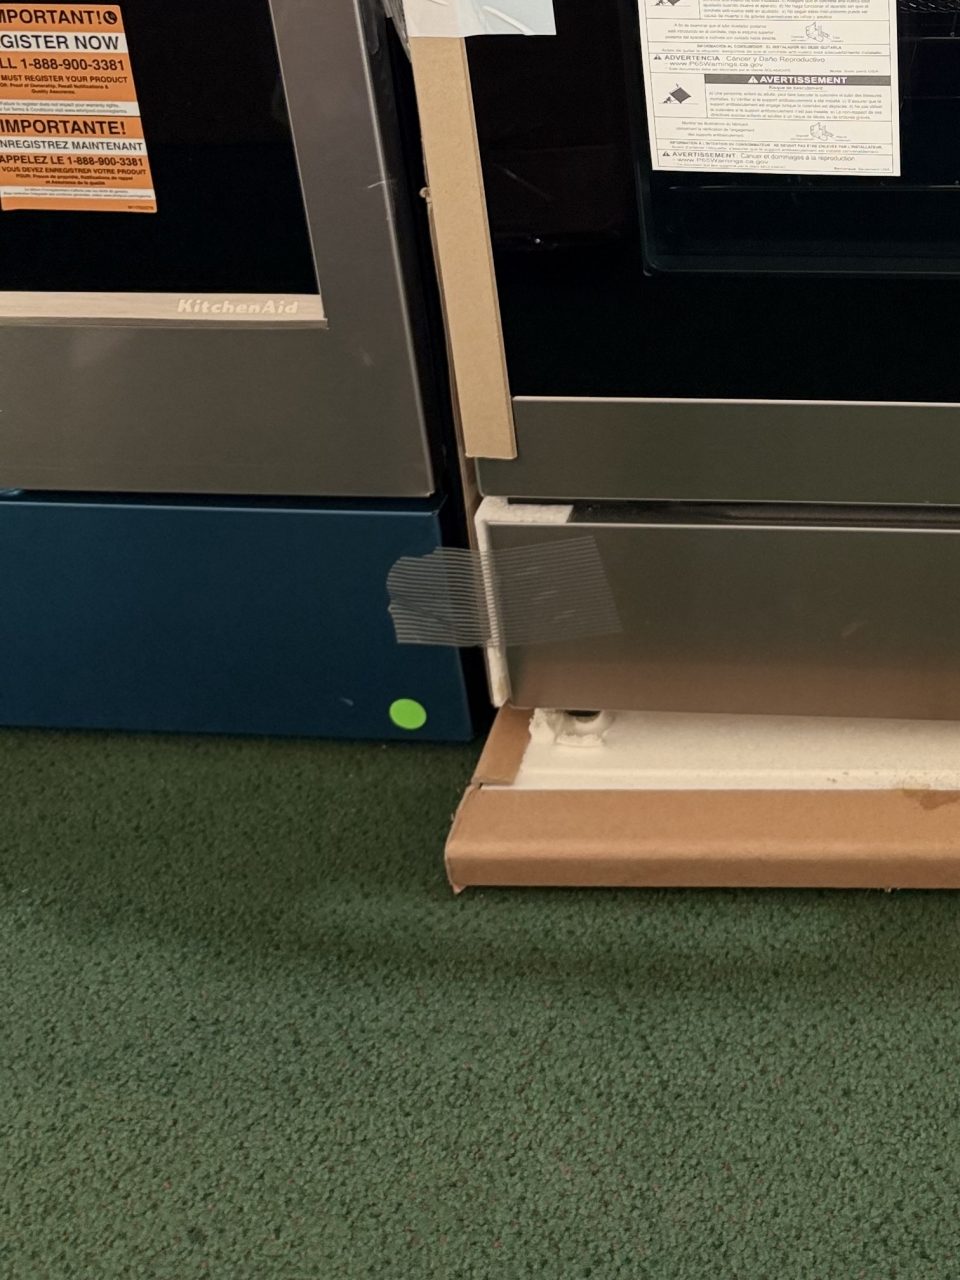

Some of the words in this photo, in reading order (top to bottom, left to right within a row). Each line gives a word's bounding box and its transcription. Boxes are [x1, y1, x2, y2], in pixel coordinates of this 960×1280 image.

[0, 34, 70, 50] GISTER
[75, 35, 119, 50] NOW
[20, 57, 125, 71] 1-888-900-3381
[1, 74, 23, 82] MUST
[66, 75, 88, 83] YOUR
[759, 76, 848, 85] AVERTISSEMENT
[0, 119, 126, 135] IMPORTANTE!
[71, 141, 144, 151] MAINTENANT
[0, 155, 48, 164] APPELEZ
[50, 156, 65, 165] LE
[66, 156, 143, 167] 1-888-900-3381
[817, 154, 856, 162] reproduction
[176, 298, 299, 315] KitchenAid
